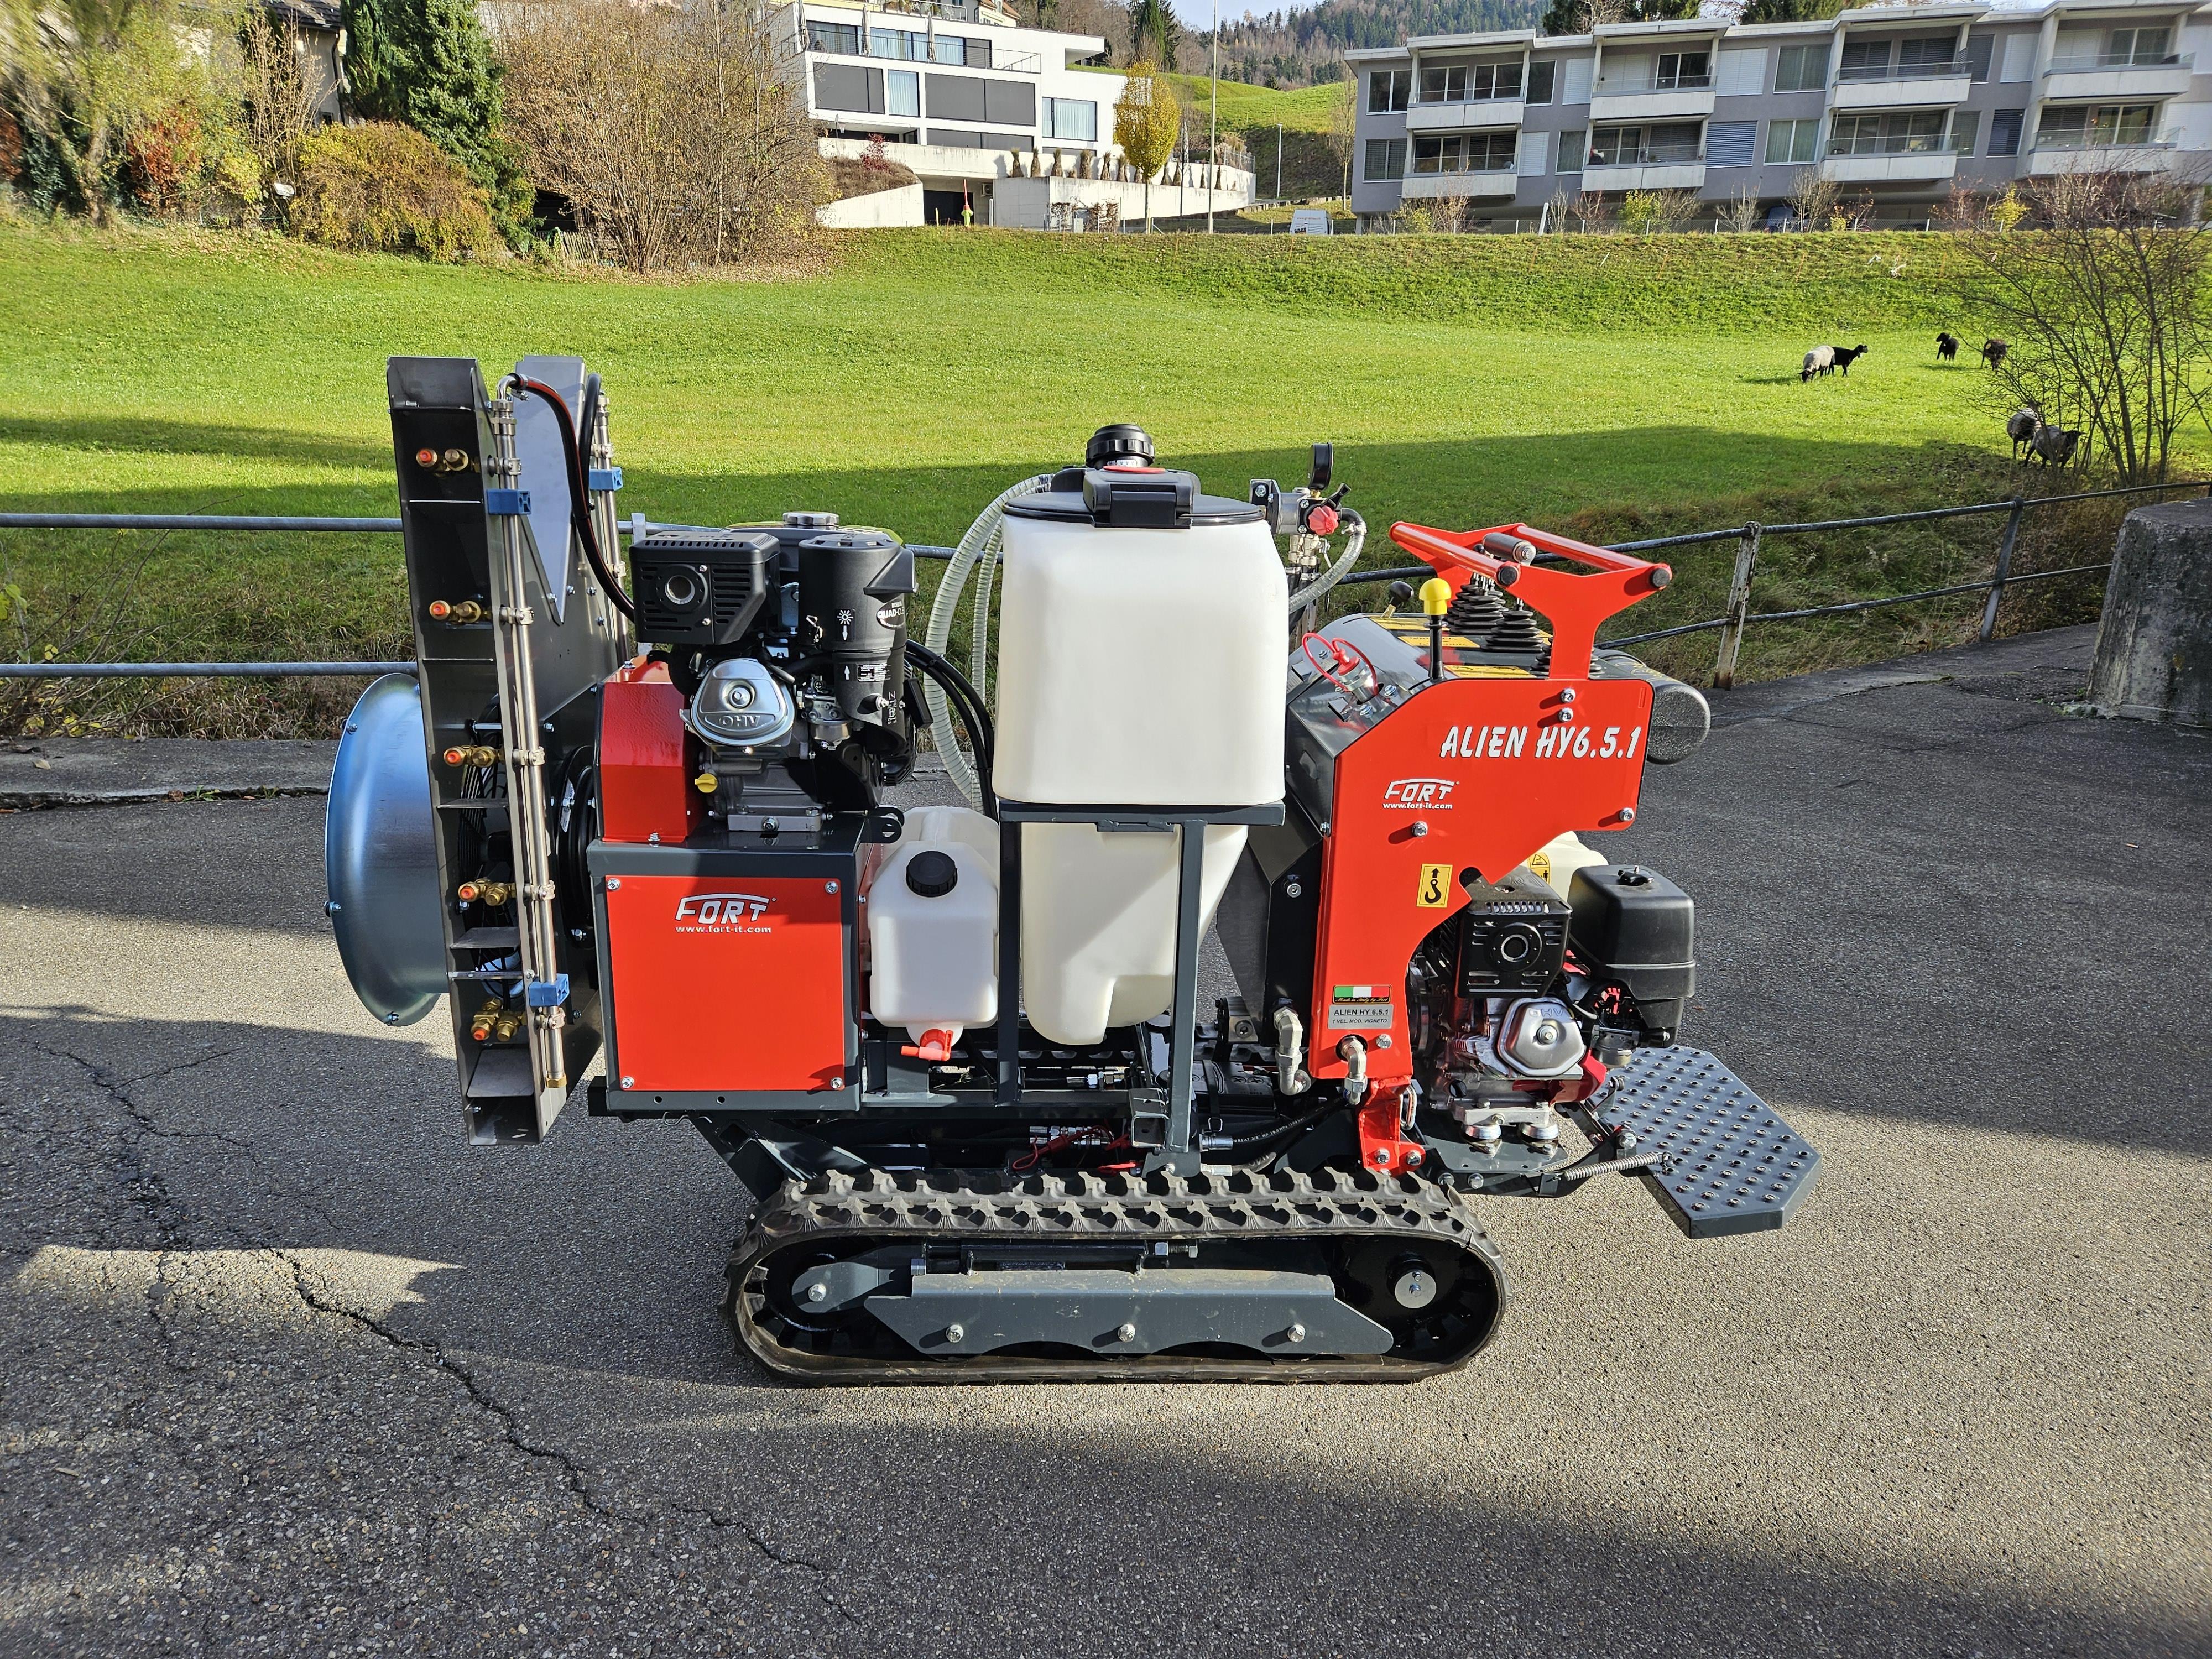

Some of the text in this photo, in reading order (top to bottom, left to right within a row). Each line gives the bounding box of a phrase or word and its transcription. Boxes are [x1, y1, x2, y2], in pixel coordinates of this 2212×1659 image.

[719, 715, 761, 727] OHV
[1439, 726, 1642, 759] ALIEN HY6.5.1
[1384, 778, 1455, 802] FORT
[675, 893, 770, 924] FORT
[675, 925, 772, 933] www.fort-it.com
[1528, 1008, 1564, 1018] OHV
